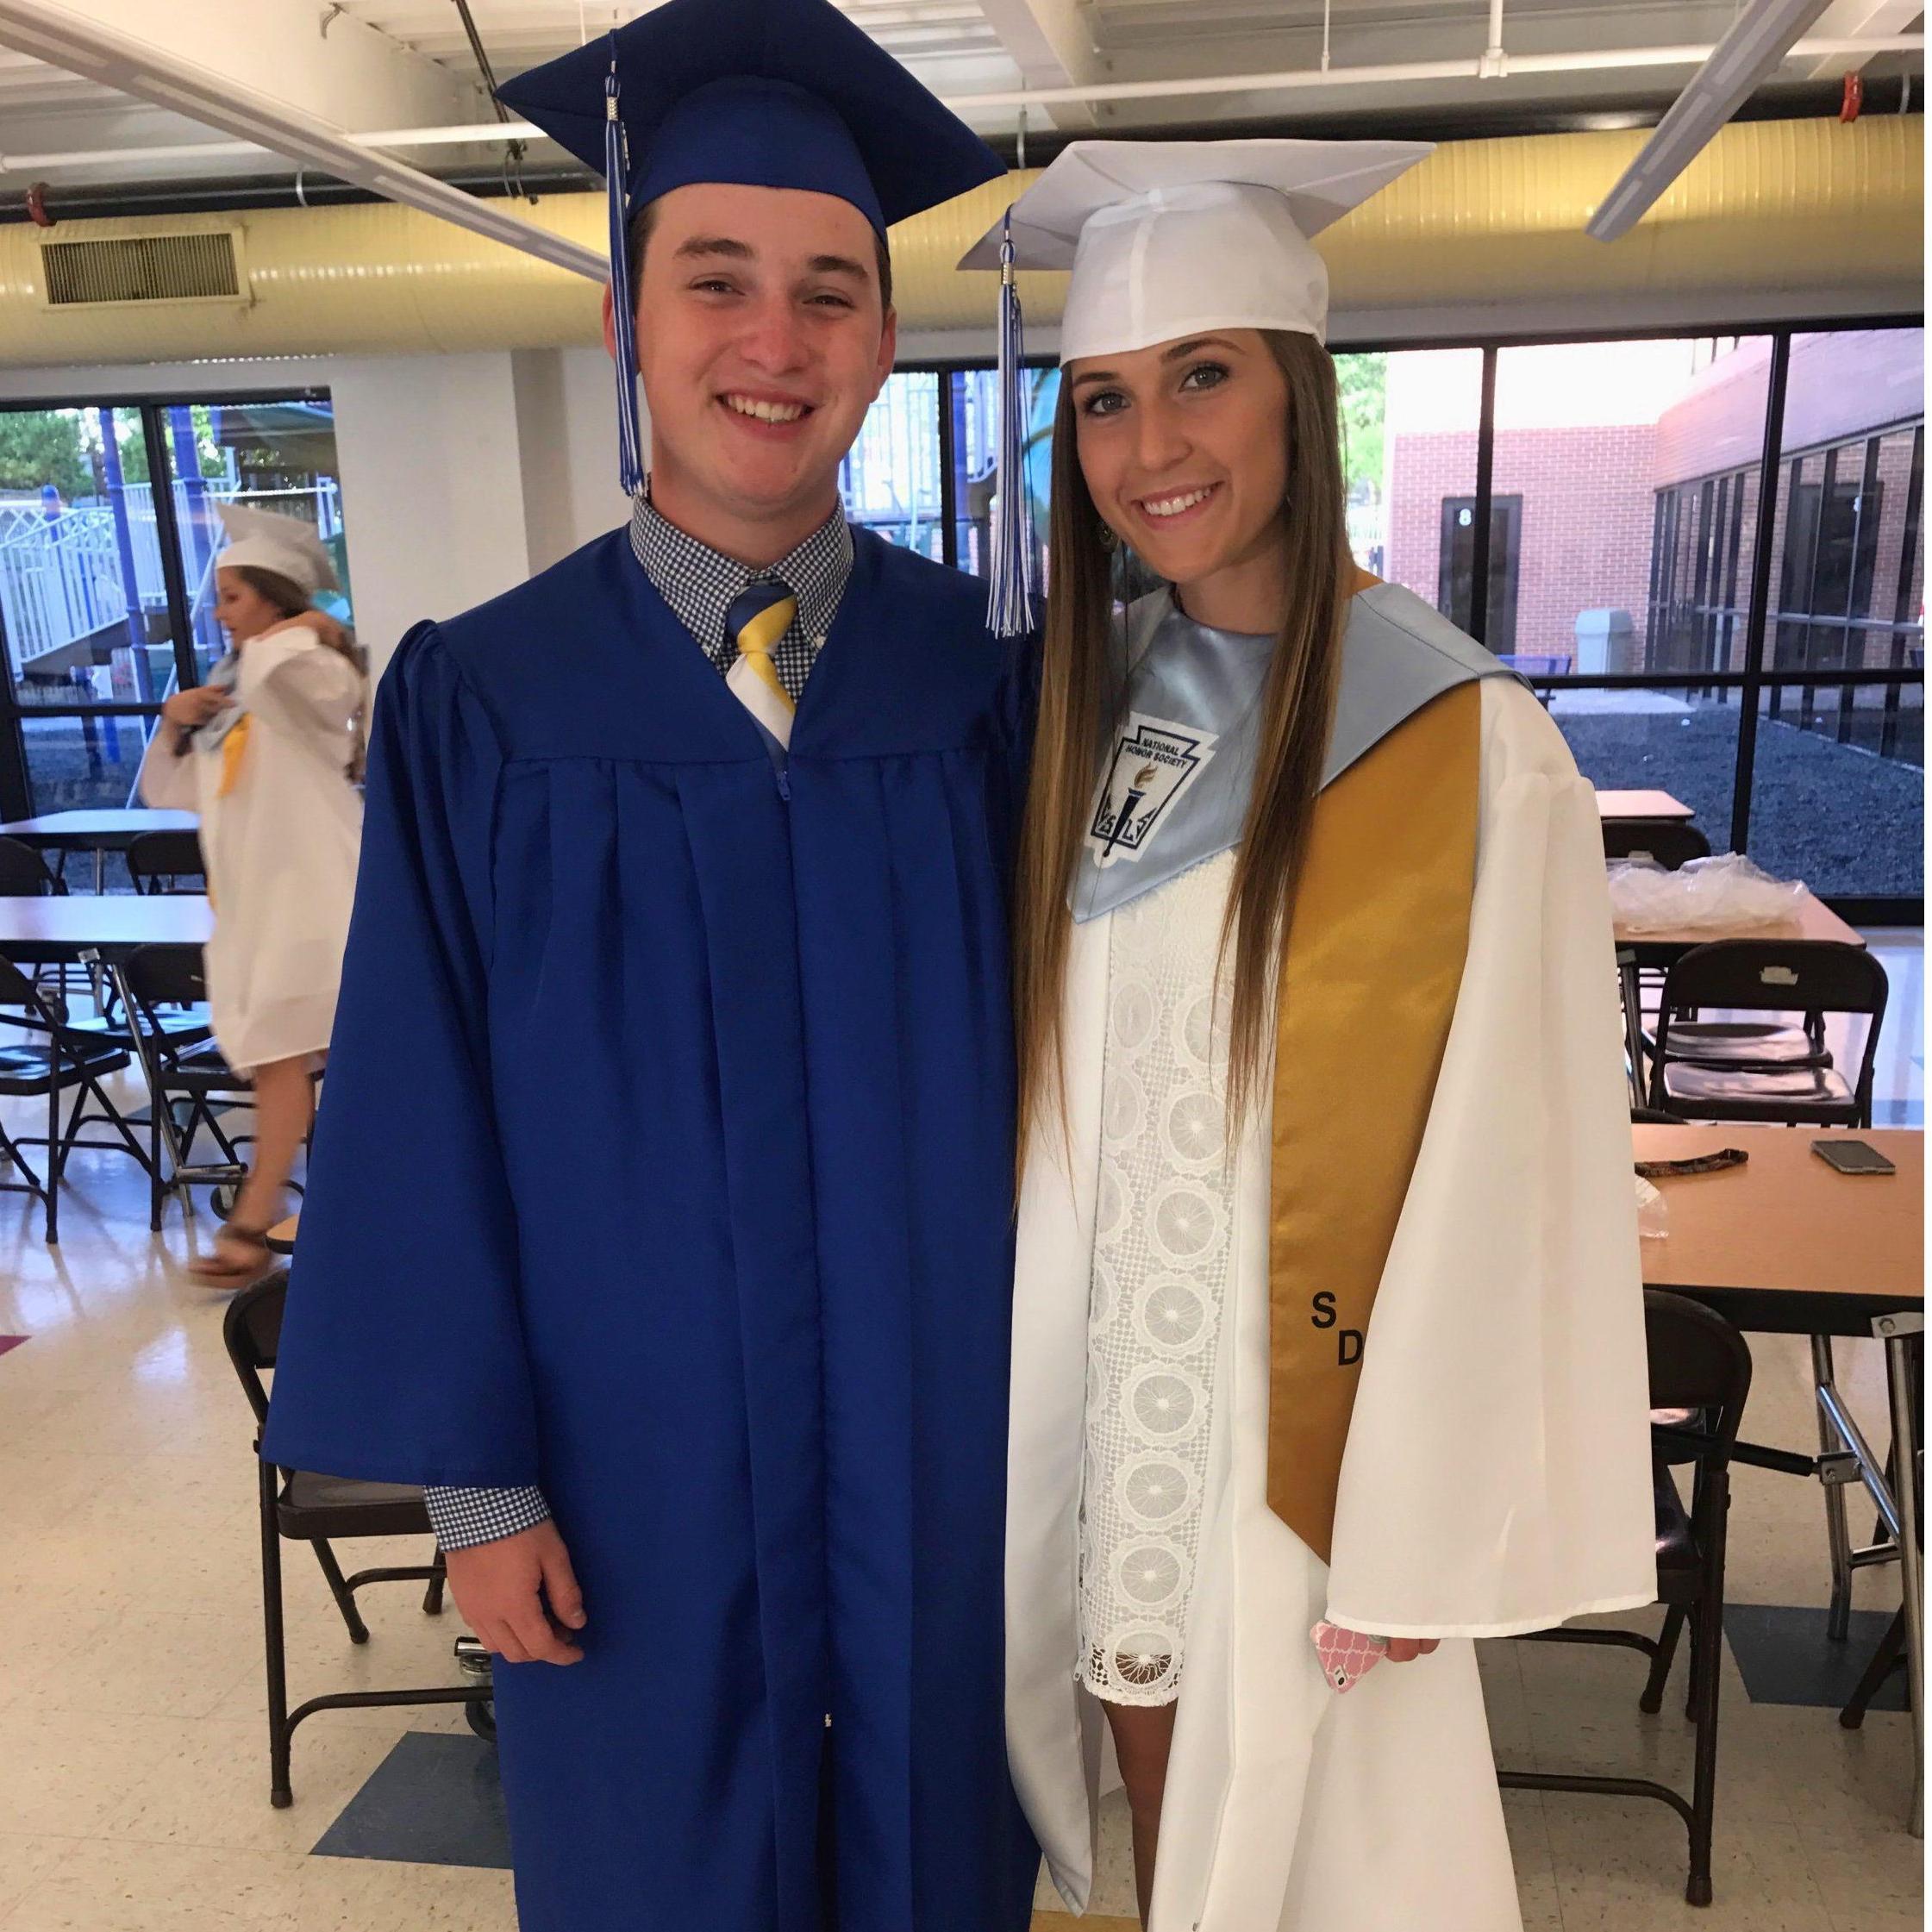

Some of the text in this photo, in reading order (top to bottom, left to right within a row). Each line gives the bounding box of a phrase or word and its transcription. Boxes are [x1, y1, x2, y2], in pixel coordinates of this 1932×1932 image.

[1459, 508, 1472, 527] 8
[1125, 744, 1188, 768] HONOR SOCIETY
[1142, 737, 1179, 756] NATIONAL
